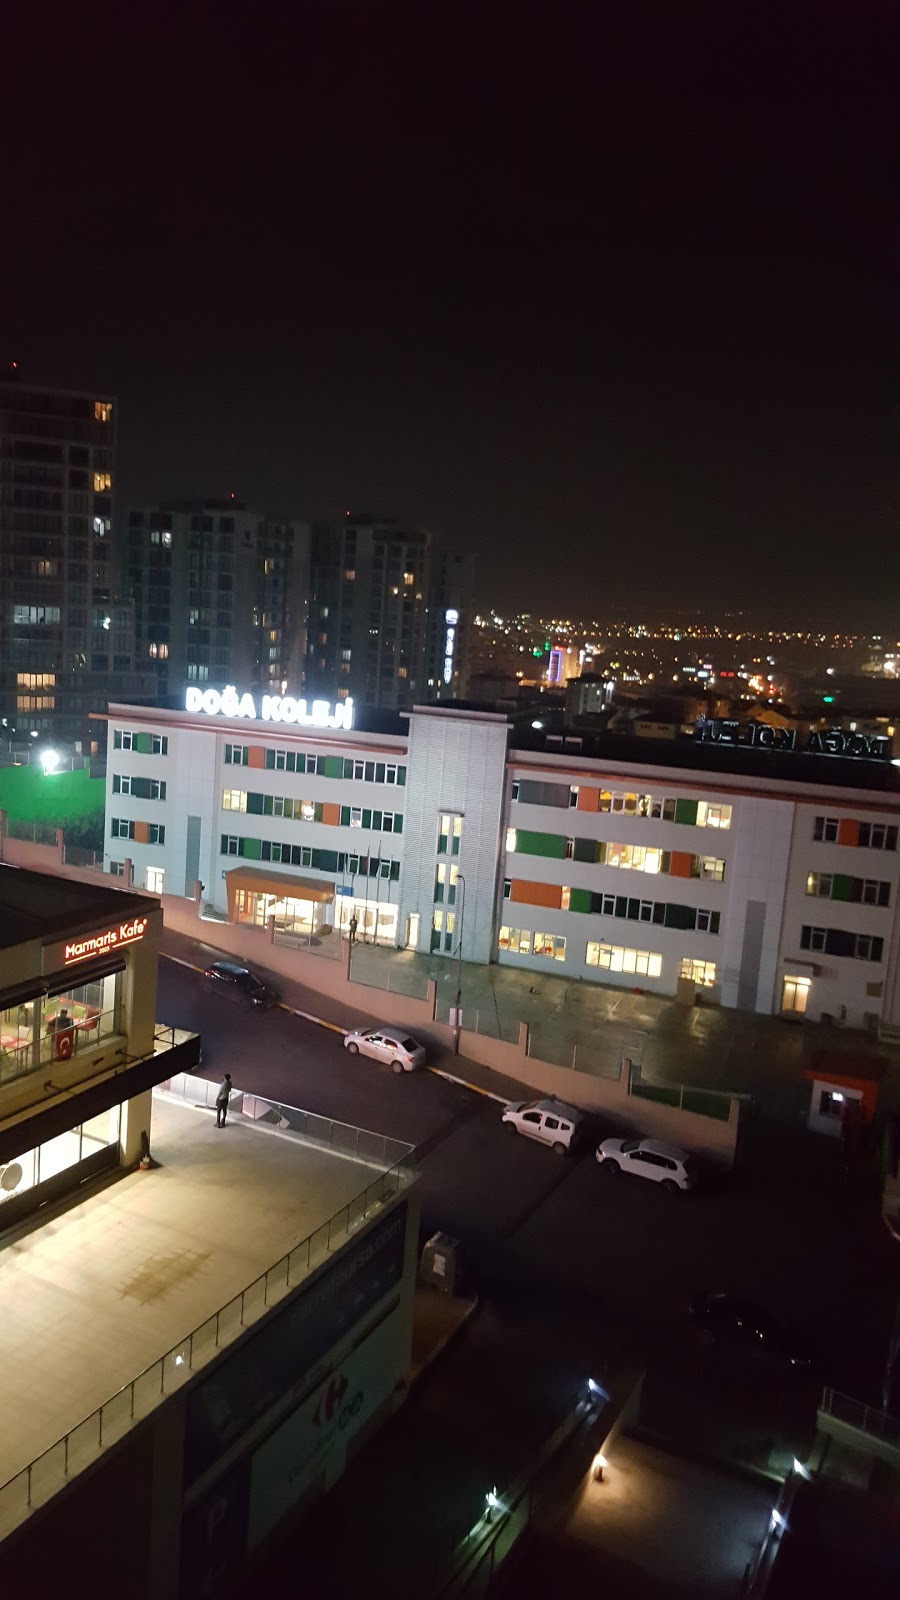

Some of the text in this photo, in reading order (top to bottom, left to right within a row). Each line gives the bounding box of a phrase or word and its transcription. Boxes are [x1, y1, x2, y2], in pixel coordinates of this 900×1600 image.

[186, 685, 353, 730] DOĞA KOLEJİ
[65, 931, 117, 958] Marmaris
